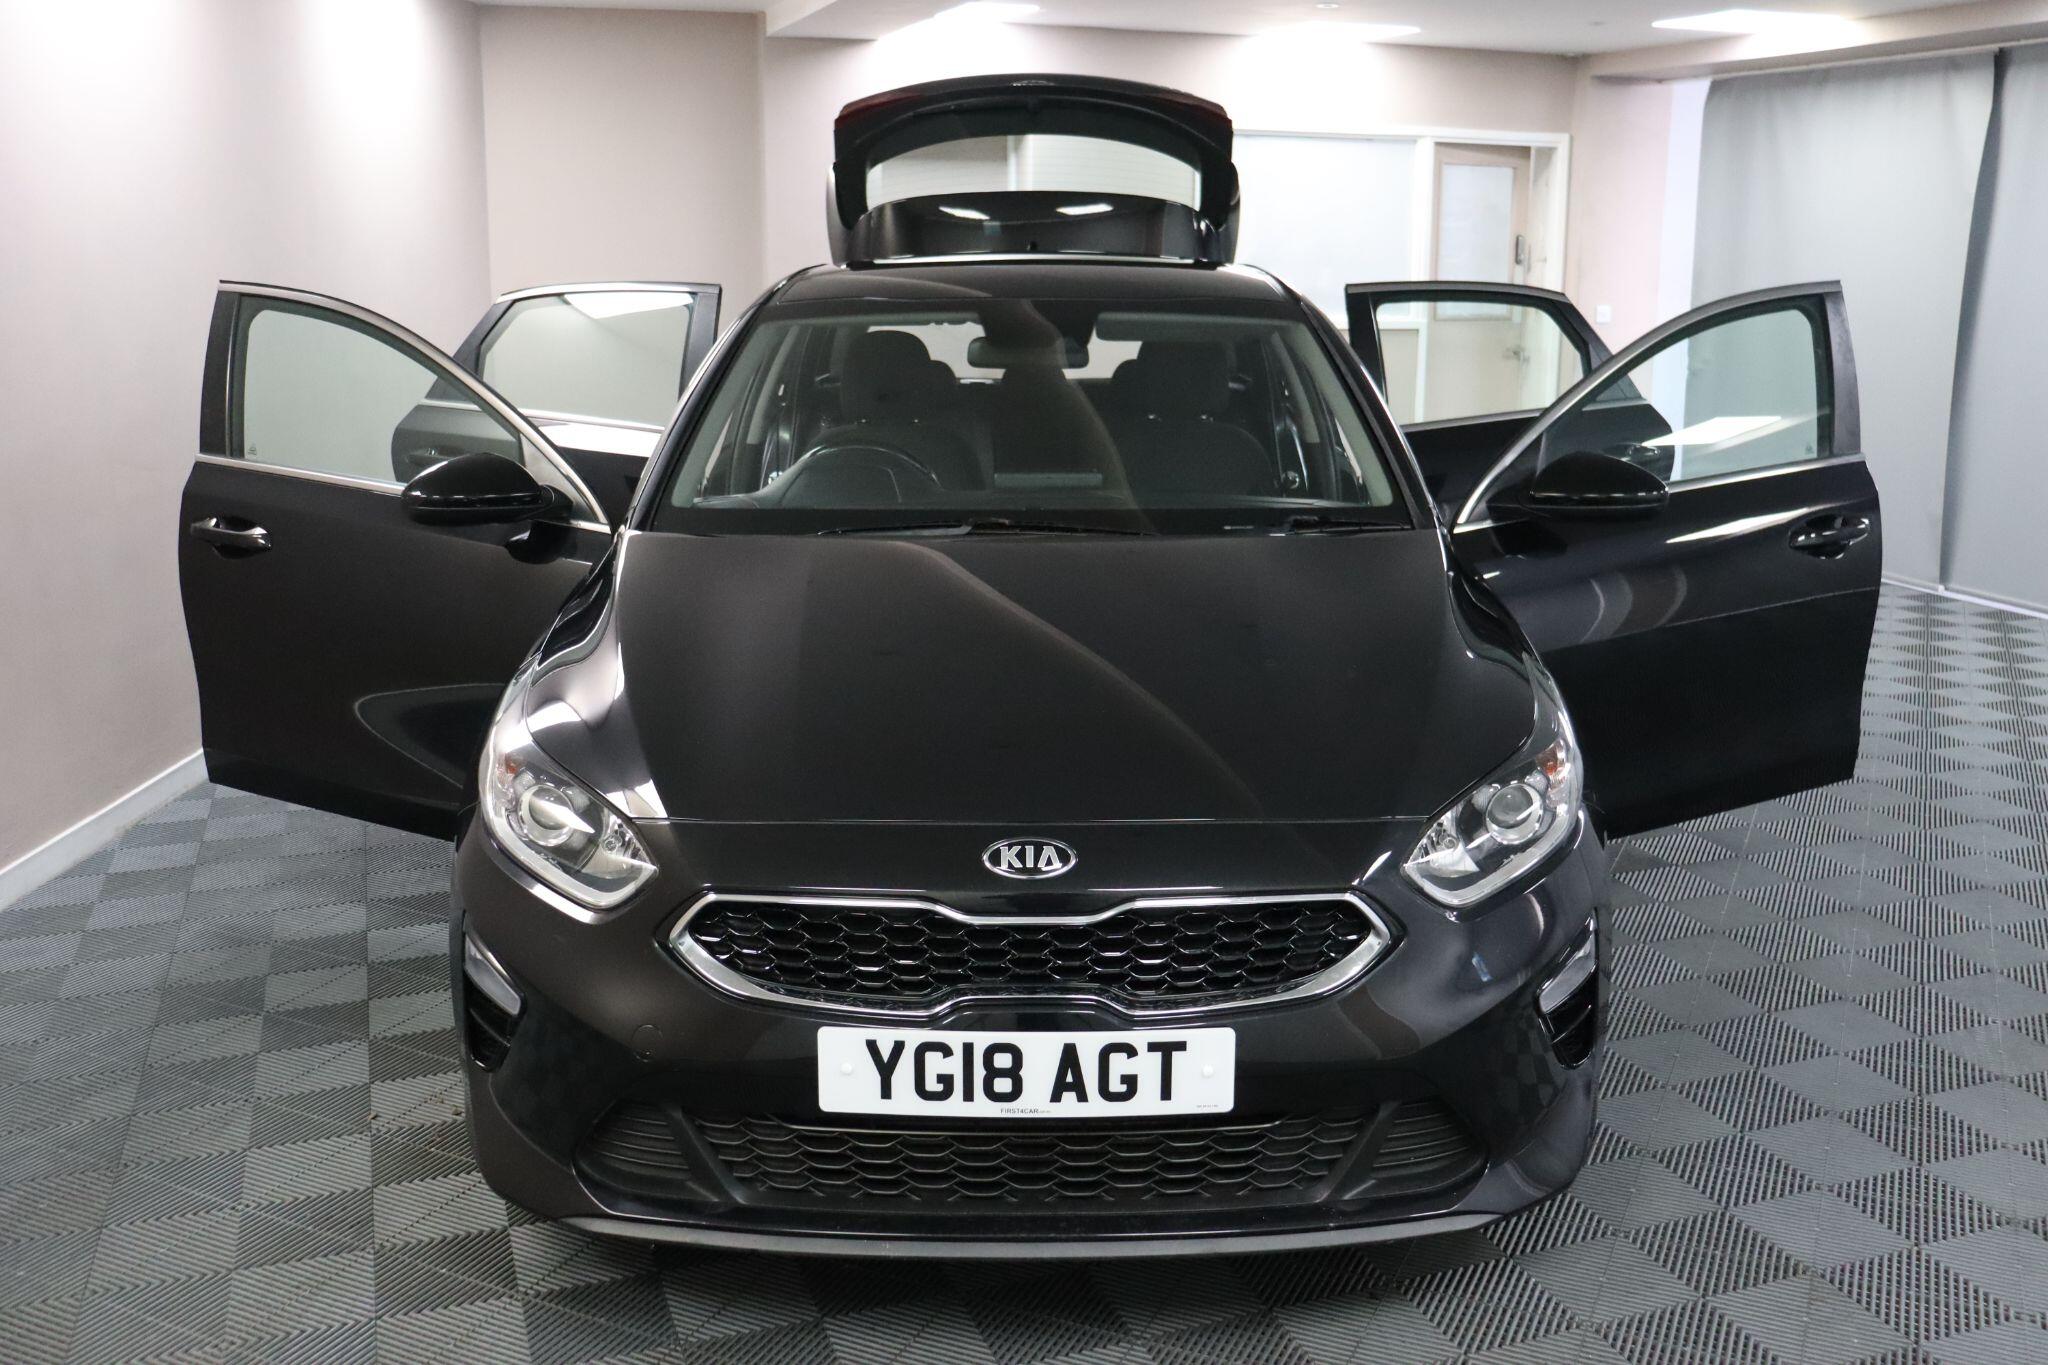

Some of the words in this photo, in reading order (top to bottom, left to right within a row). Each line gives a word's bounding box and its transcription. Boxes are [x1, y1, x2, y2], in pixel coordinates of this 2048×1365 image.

[997, 845, 1063, 872] KIA
[865, 1039, 1024, 1103] YG18
[1049, 1040, 1188, 1103] AGT
